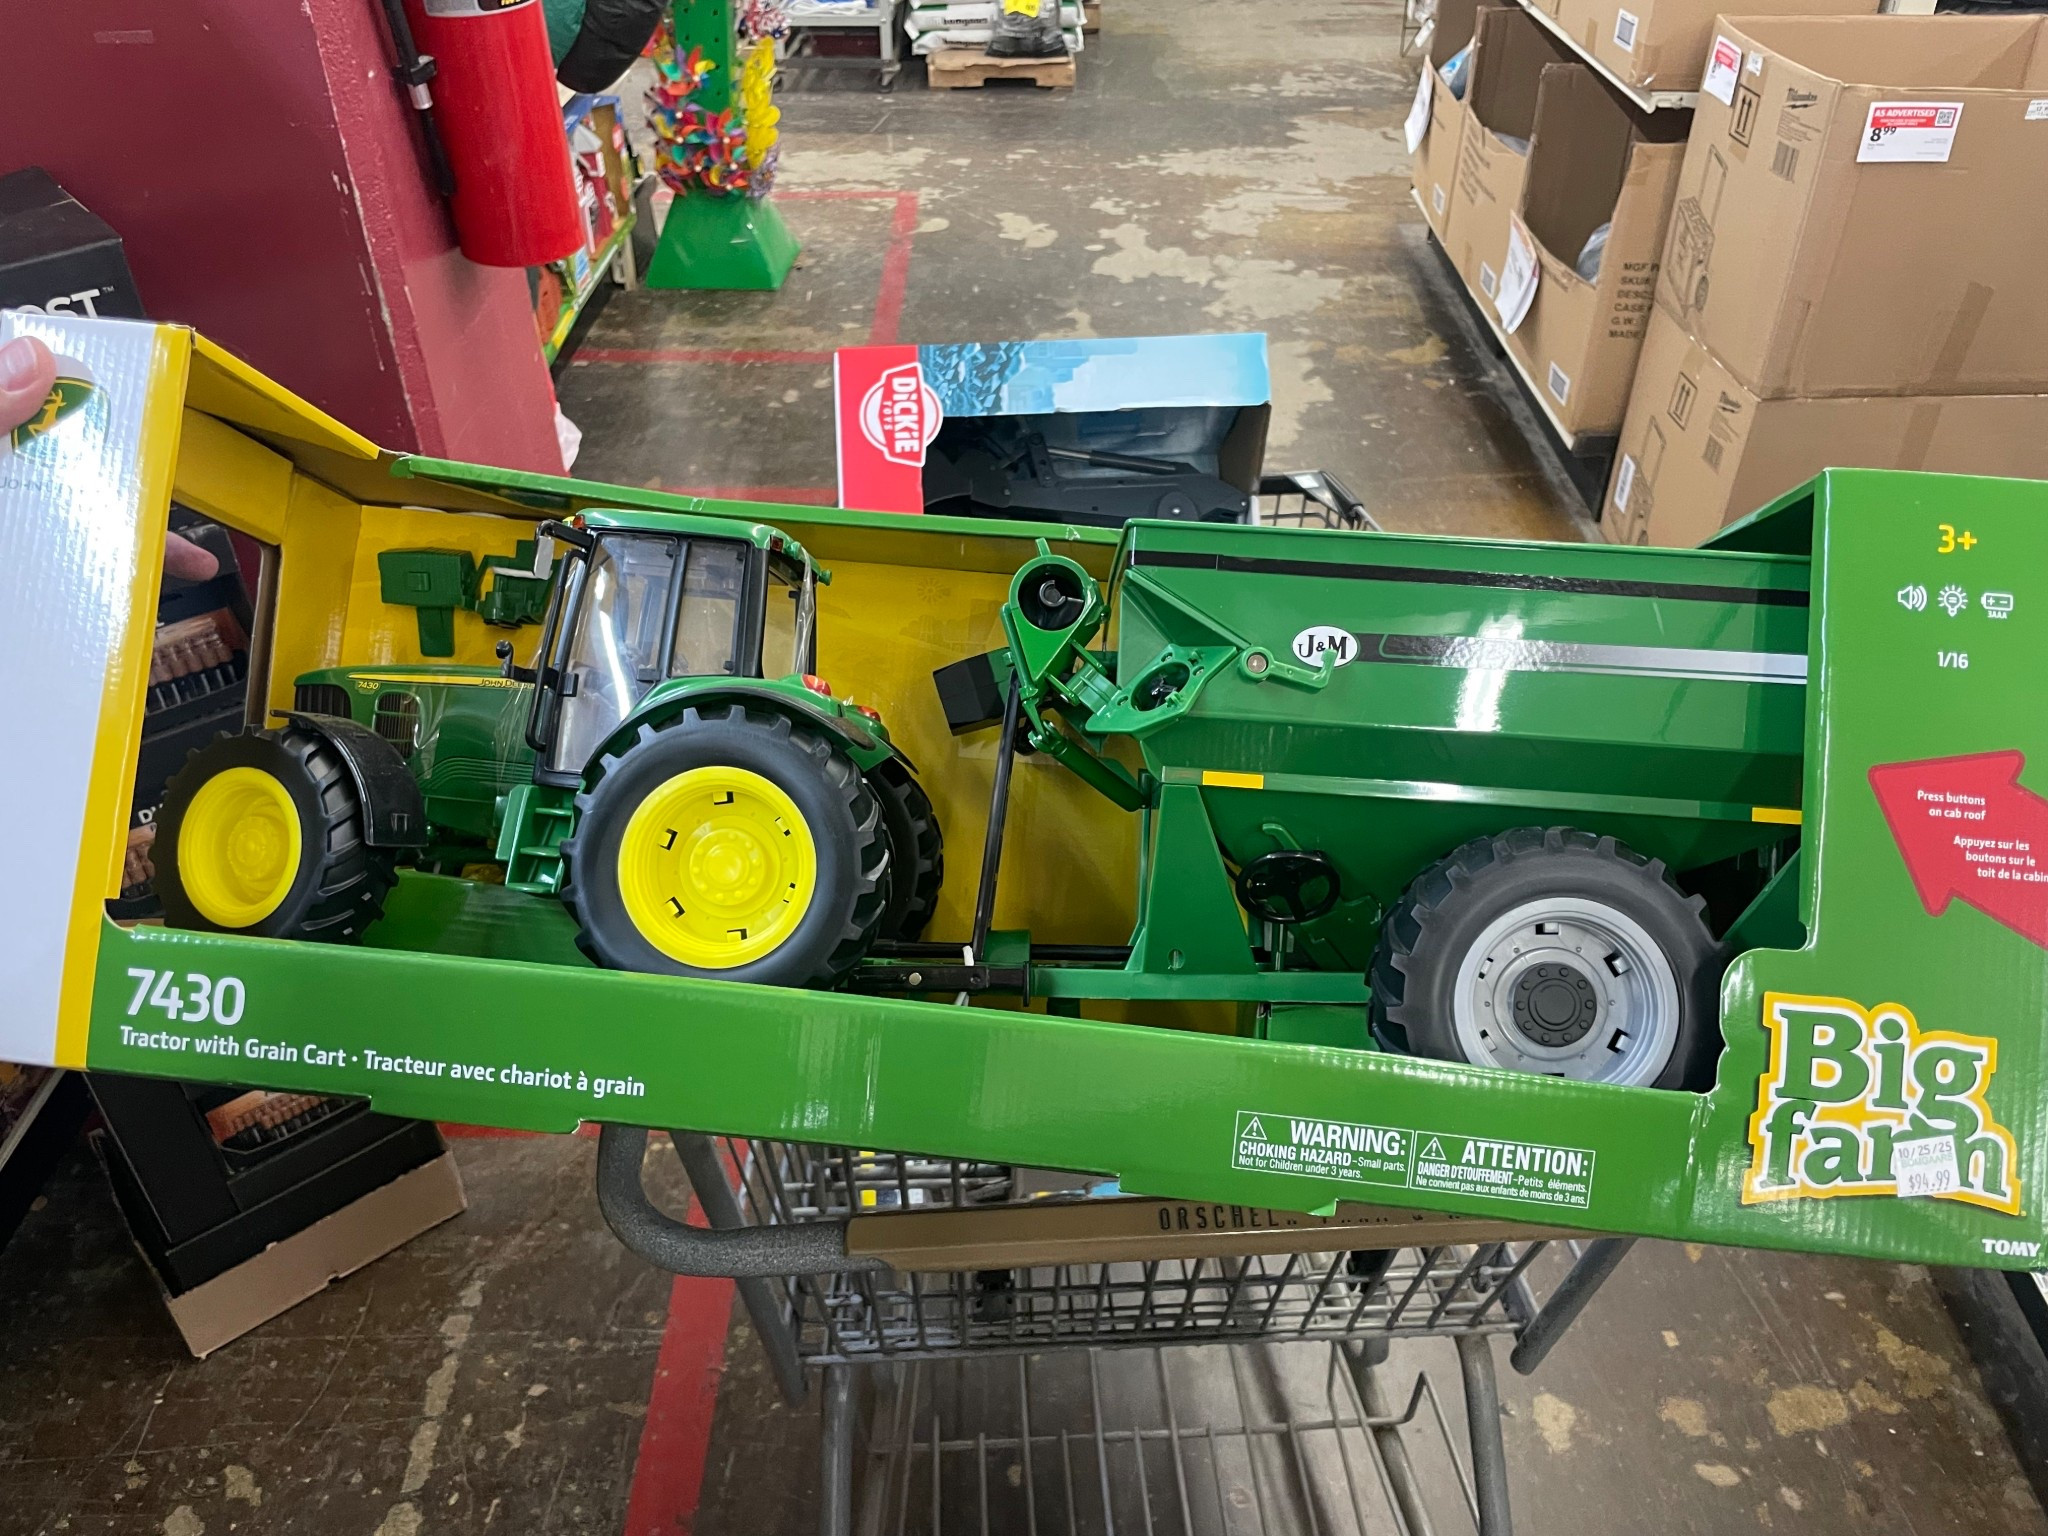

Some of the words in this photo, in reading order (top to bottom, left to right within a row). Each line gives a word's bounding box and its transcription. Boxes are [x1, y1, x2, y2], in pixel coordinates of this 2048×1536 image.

[1875, 109, 1886, 117] AS
[1887, 109, 1936, 117] ADVERTISED
[883, 401, 893, 430] TOYS
[1937, 524, 1978, 553] 3+
[1987, 611, 2008, 619] 3AAA
[1298, 634, 1348, 660] J&M
[1937, 652, 1969, 669] 1/16
[357, 680, 379, 690] 7430
[1917, 790, 1944, 802] Press
[1946, 792, 1985, 806] buttons
[1929, 808, 1942, 816] on
[1944, 808, 1961, 818] cab
[1964, 810, 1986, 820] roof
[1953, 836, 1996, 850] Appuyez
[1997, 841, 2013, 850] sur
[2016, 840, 2029, 851] les
[1966, 850, 2006, 864] boutons
[2009, 856, 2024, 865] sur
[2027, 856, 2035, 867] le
[1977, 867, 1996, 878] toit
[1998, 869, 2010, 879] de
[2012, 870, 2021, 880] la
[127, 967, 245, 1026] 7430
[120, 1026, 190, 1051] Tractor
[195, 1035, 239, 1056] with
[245, 1039, 297, 1062] Grain
[303, 1044, 346, 1067] Cart
[363, 1049, 446, 1076] Tracteur
[450, 1063, 495, 1082] avec
[500, 1064, 572, 1090] chariot
[577, 1071, 588, 1091] à
[593, 1076, 645, 1099] grain
[1774, 1006, 1985, 1141] Big
[1290, 1120, 1406, 1156] WARNING:
[1898, 1141, 1952, 1158] 10/25/25
[1239, 1140, 1297, 1160] CHOKING
[1383, 1160, 1406, 1172] parts.
[1239, 1155, 1253, 1166] Not
[1256, 1156, 1267, 1167] for
[1269, 1160, 1303, 1172] Children
[1306, 1164, 1328, 1175] under
[1331, 1165, 1336, 1175] 3
[1338, 1168, 1363, 1179] years.
[1461, 1140, 1588, 1177] ATTENTION:
[1417, 1161, 1450, 1178] DANGER
[1548, 1177, 1587, 1193] éléments.
[1909, 1169, 1950, 1191] $94.99
[1416, 1175, 1427, 1186] Ne
[1428, 1178, 1460, 1191] convient
[1461, 1181, 1474, 1193] pas
[1476, 1184, 1490, 1193] aux
[1491, 1185, 1518, 1197] enfants
[1519, 1188, 1529, 1198] de
[1530, 1190, 1552, 1201] moins
[1554, 1192, 1563, 1202] de
[1564, 1192, 1570, 1202] 3
[1570, 1195, 1586, 1205] ans.
[1982, 1239, 2042, 1257] TOMY
